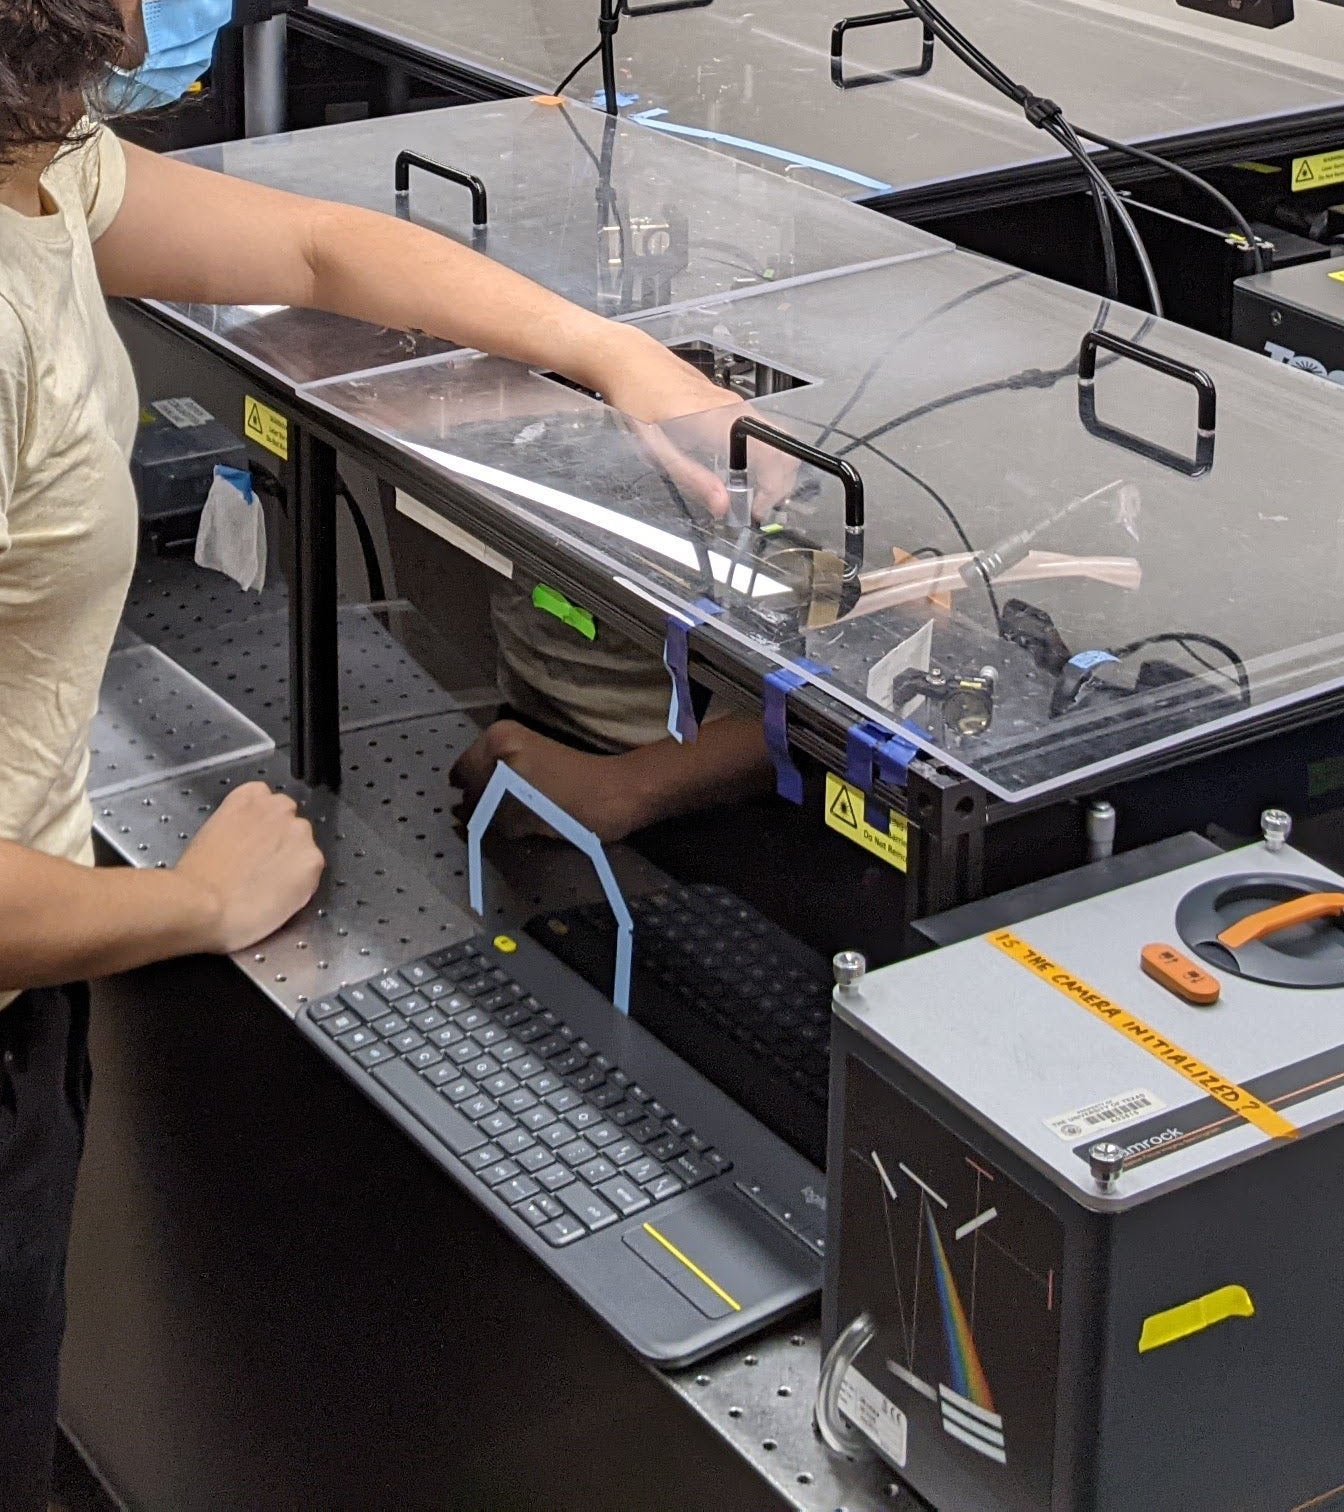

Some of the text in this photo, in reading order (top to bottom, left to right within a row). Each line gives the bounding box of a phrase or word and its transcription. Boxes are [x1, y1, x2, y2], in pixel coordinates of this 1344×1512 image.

[864, 829, 873, 843] Do
[875, 836, 887, 851] Not
[995, 933, 1020, 949] IS
[1023, 948, 1055, 972] THE
[1051, 973, 1122, 1018] CAMERA
[1121, 1092, 1146, 1105] TEXAS
